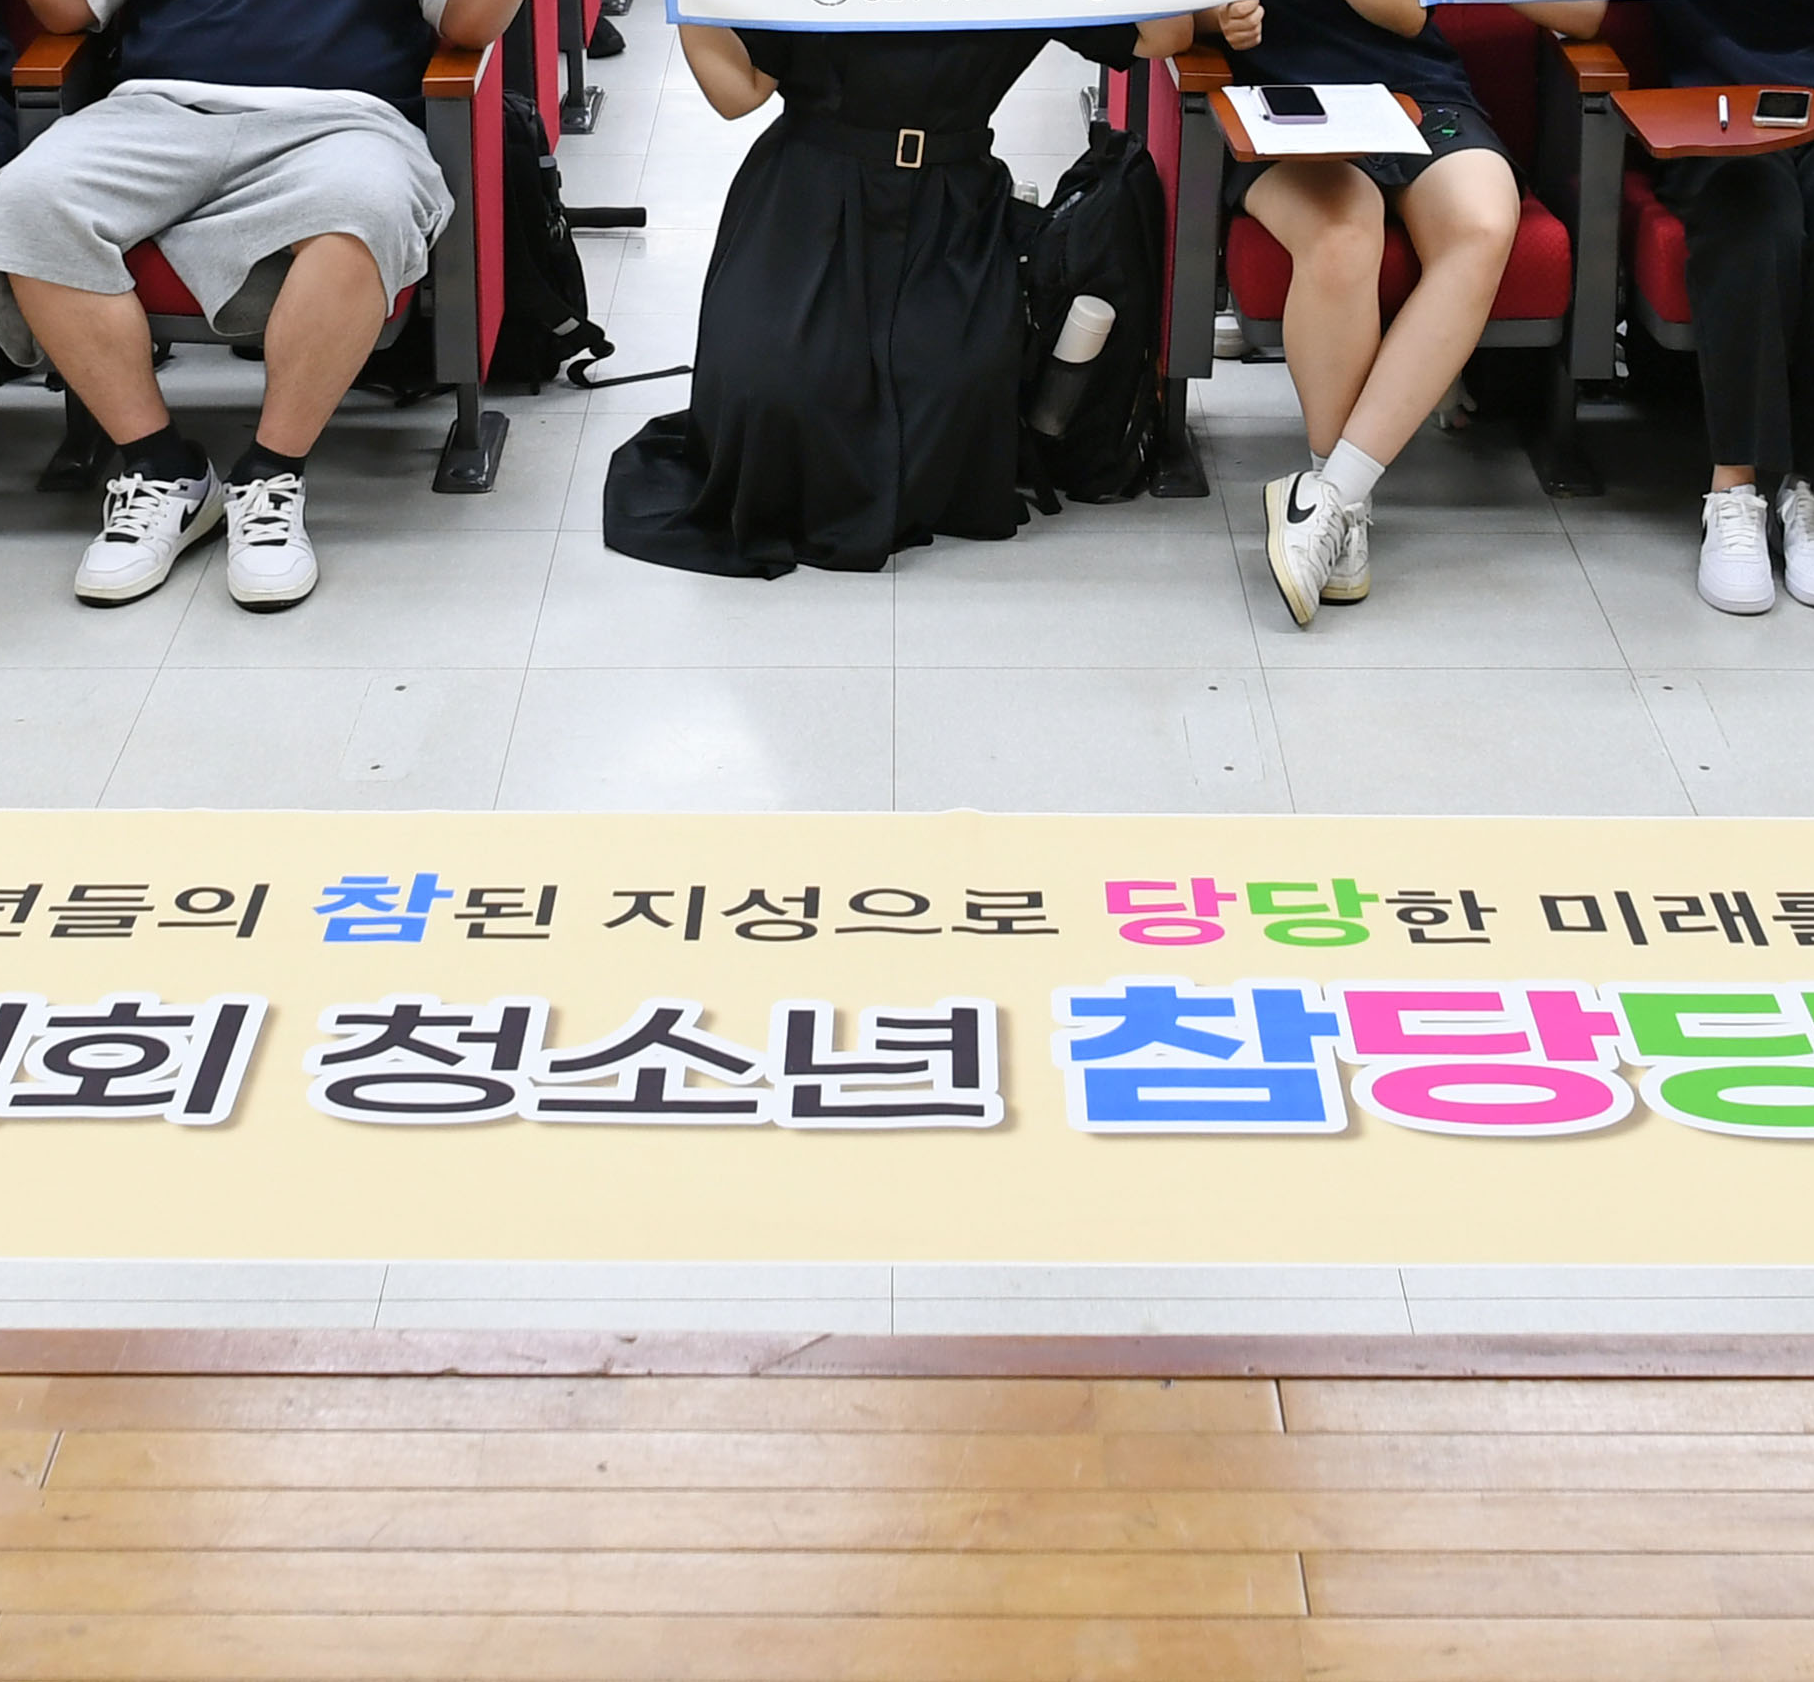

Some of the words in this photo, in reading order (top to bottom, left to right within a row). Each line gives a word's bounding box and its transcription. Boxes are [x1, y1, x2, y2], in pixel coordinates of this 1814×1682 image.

[309, 872, 562, 944] 참된
[601, 883, 1062, 942] 지성으로
[1101, 876, 1500, 948] 당당한
[316, 998, 991, 1120] 청소년
